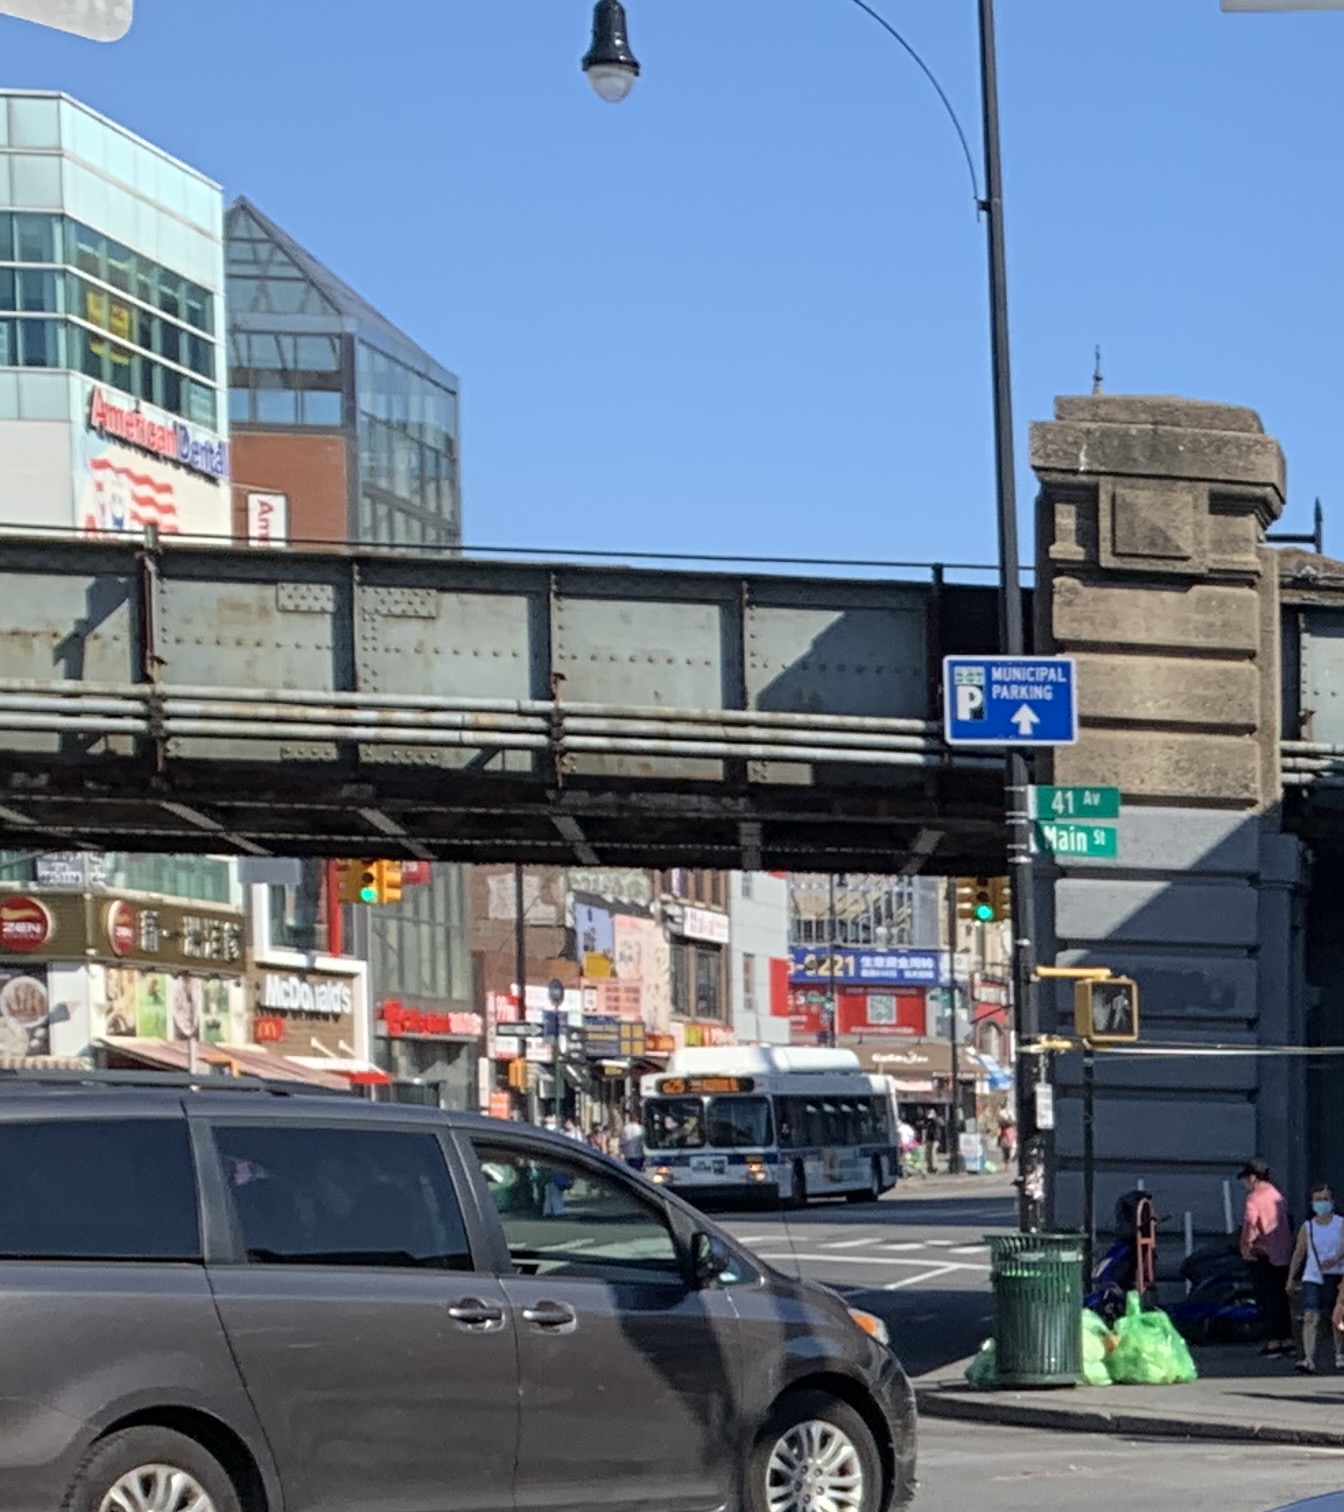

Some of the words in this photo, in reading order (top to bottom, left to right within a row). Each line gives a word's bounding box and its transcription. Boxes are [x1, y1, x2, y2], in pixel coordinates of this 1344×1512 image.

[991, 666, 1067, 683] MUNICIPAL
[991, 684, 1054, 700] PARKING
[1050, 790, 1075, 814] 41
[1083, 790, 1101, 806] Av
[1044, 825, 1088, 852] Main
[1093, 828, 1106, 846] St
[2, 920, 42, 933] ZEN
[265, 973, 352, 1014] McDonald's
